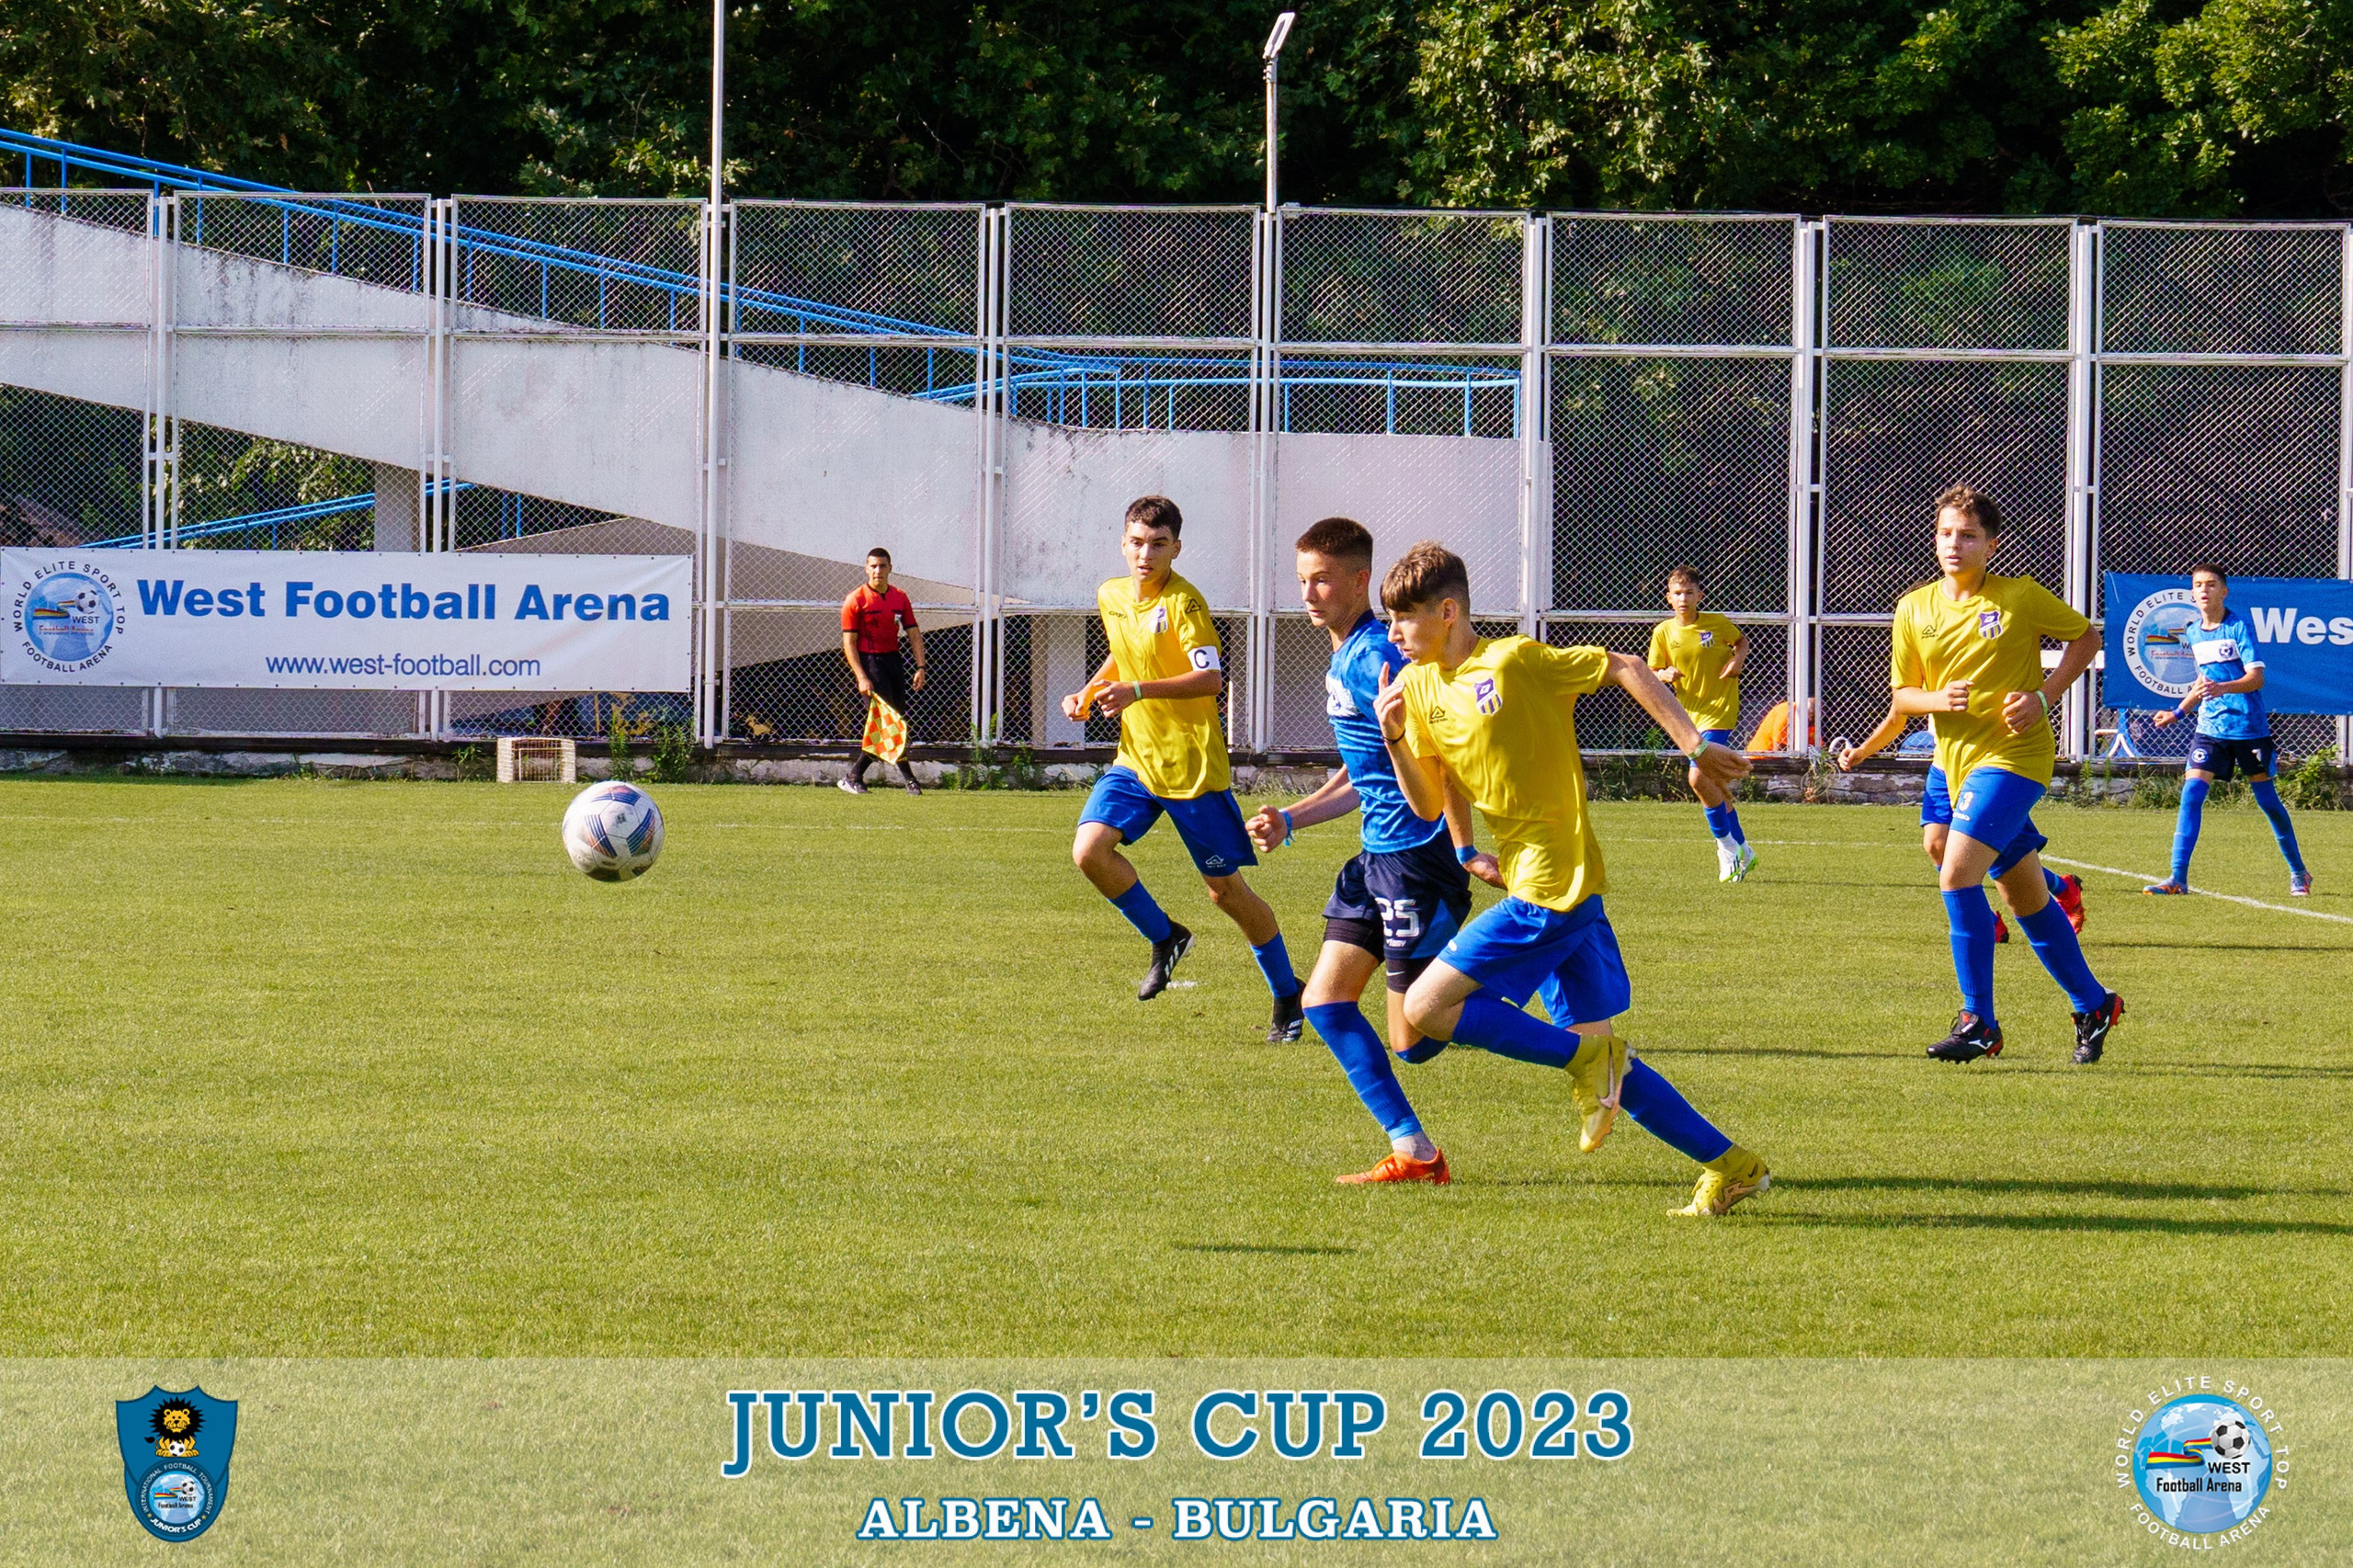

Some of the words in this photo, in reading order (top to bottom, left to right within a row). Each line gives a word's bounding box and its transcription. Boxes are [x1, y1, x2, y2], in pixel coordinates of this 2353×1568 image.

[13, 581, 32, 632] WORLD
[34, 561, 75, 580] ELITE
[83, 563, 121, 599] SPORT
[115, 606, 126, 635] TOP
[136, 579, 266, 617] West
[285, 581, 496, 620] Football
[514, 584, 670, 621] Arena
[72, 616, 100, 624] WEST
[2127, 609, 2144, 657] WORLD
[2146, 592, 2184, 608] ELITE
[22, 642, 75, 673] FOOTBALL
[79, 644, 113, 671] ARENA
[266, 653, 541, 676] www.west-football.com
[1193, 649, 1211, 669] C
[2134, 665, 2184, 695] FOOTBALL
[1959, 791, 1973, 812] 3
